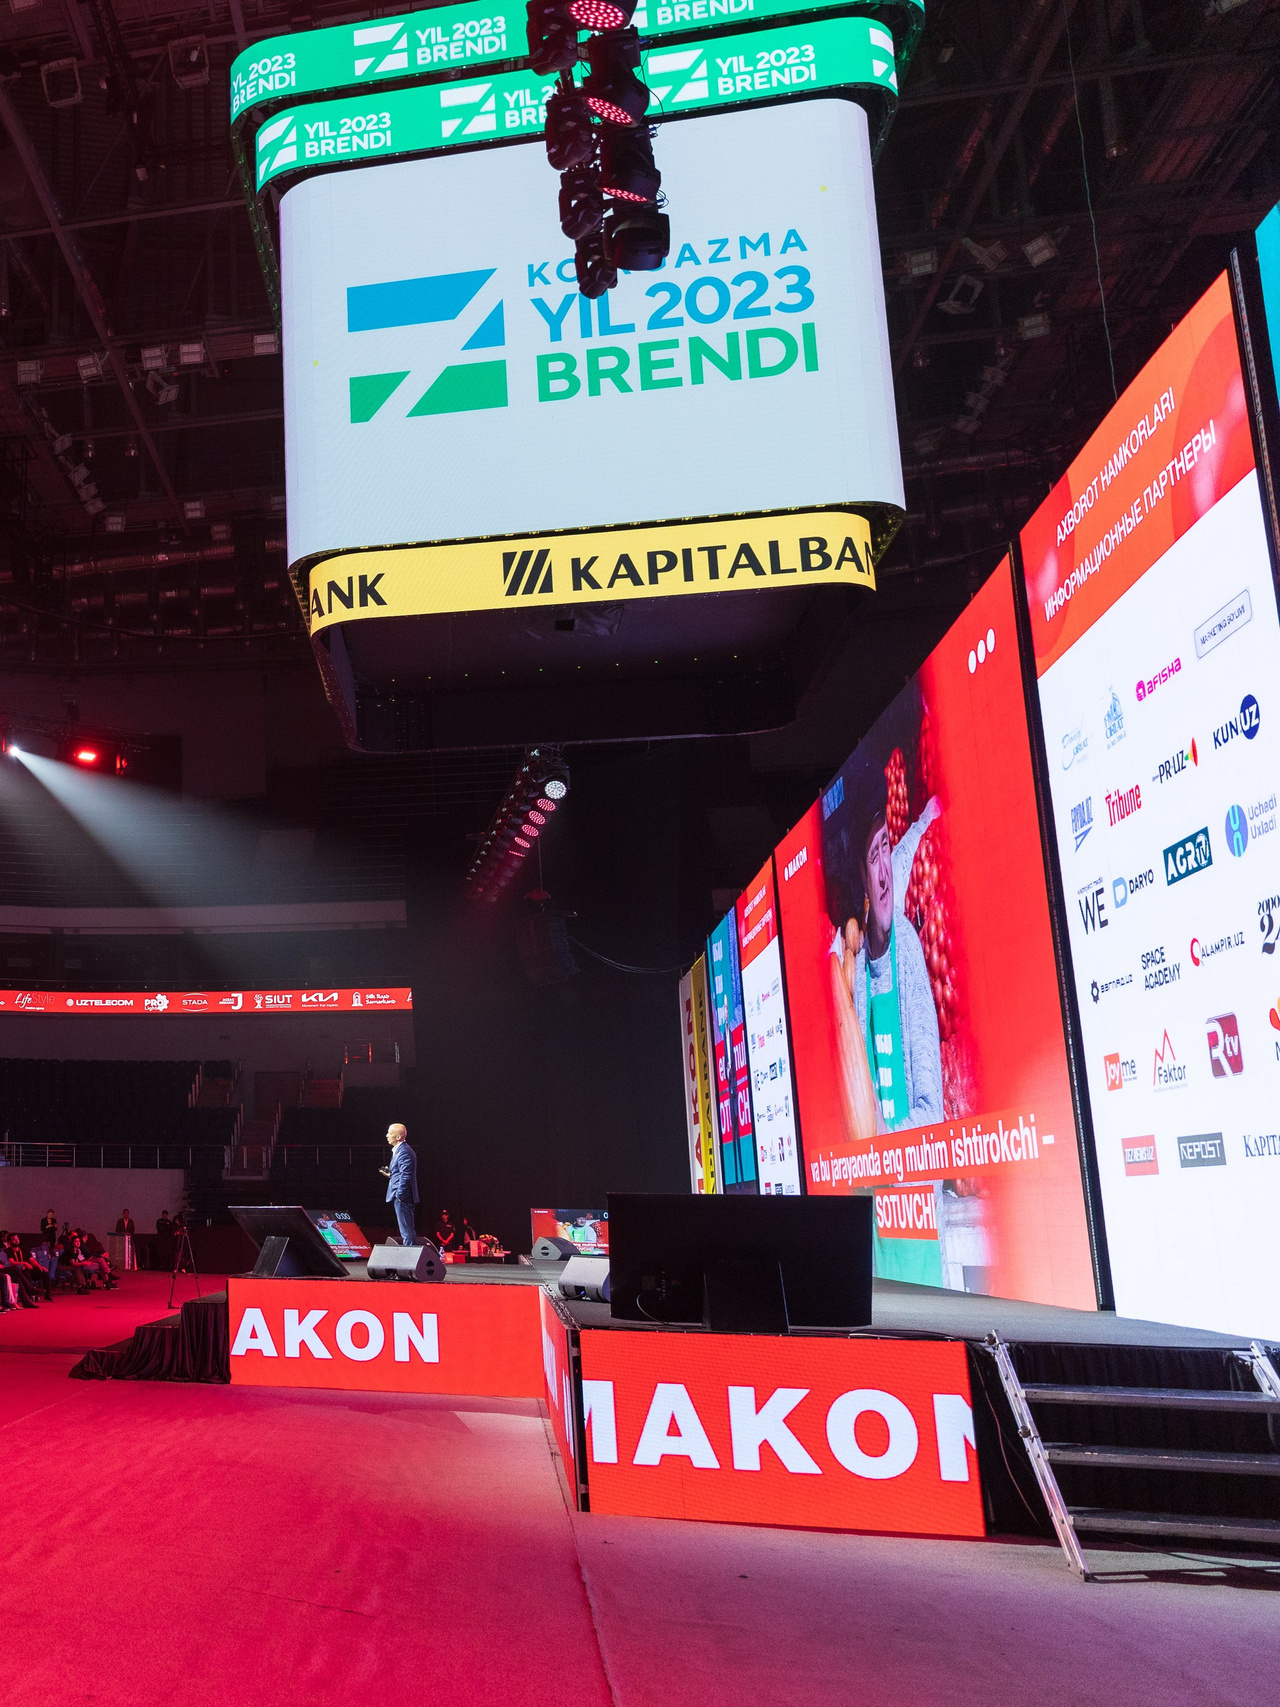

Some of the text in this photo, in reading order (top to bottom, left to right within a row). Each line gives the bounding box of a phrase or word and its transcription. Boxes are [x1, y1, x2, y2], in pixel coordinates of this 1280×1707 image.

[415, 16, 506, 46] YIL 2023
[417, 34, 507, 65] BRENDI
[715, 44, 815, 75] YIL 2023
[249, 53, 296, 81] 2023
[717, 64, 816, 96] BRENDI
[233, 71, 296, 114] BRENDI
[503, 88, 538, 108] YIL
[304, 112, 391, 140] YIL 2023
[305, 130, 391, 158] BRENDI
[530, 265, 815, 342] YIL 2023
[536, 322, 819, 403] BRENDI
[1056, 387, 1175, 547] AXBOROT HAMKORLARI
[1045, 420, 1216, 622] ИНФОРМАЦИОННЫЕ ПАРТНЕРЫ
[1248, 793, 1277, 820] Uchadi
[1250, 814, 1277, 840] Uxladi
[787, 846, 808, 878] MAKON
[1129, 869, 1154, 895] DARYO
[1078, 887, 1109, 936] WE
[1141, 946, 1166, 970] SPACE
[1144, 963, 1181, 991] ACADEMY
[75, 999, 134, 1007] UZTELECOM
[144, 998, 164, 1007] PRO
[265, 994, 293, 1004] SIUT
[1158, 1064, 1186, 1085] Faktor
[810, 1159, 820, 1183] va
[819, 1153, 831, 1181] bu
[829, 1144, 882, 1187] jarayaonda
[882, 1150, 904, 1182] eng
[905, 1132, 949, 1173] muhim
[950, 1113, 1039, 1168] ishtirokchi
[875, 1192, 937, 1229] SOTUVCHI
[230, 1307, 440, 1364] AKON
